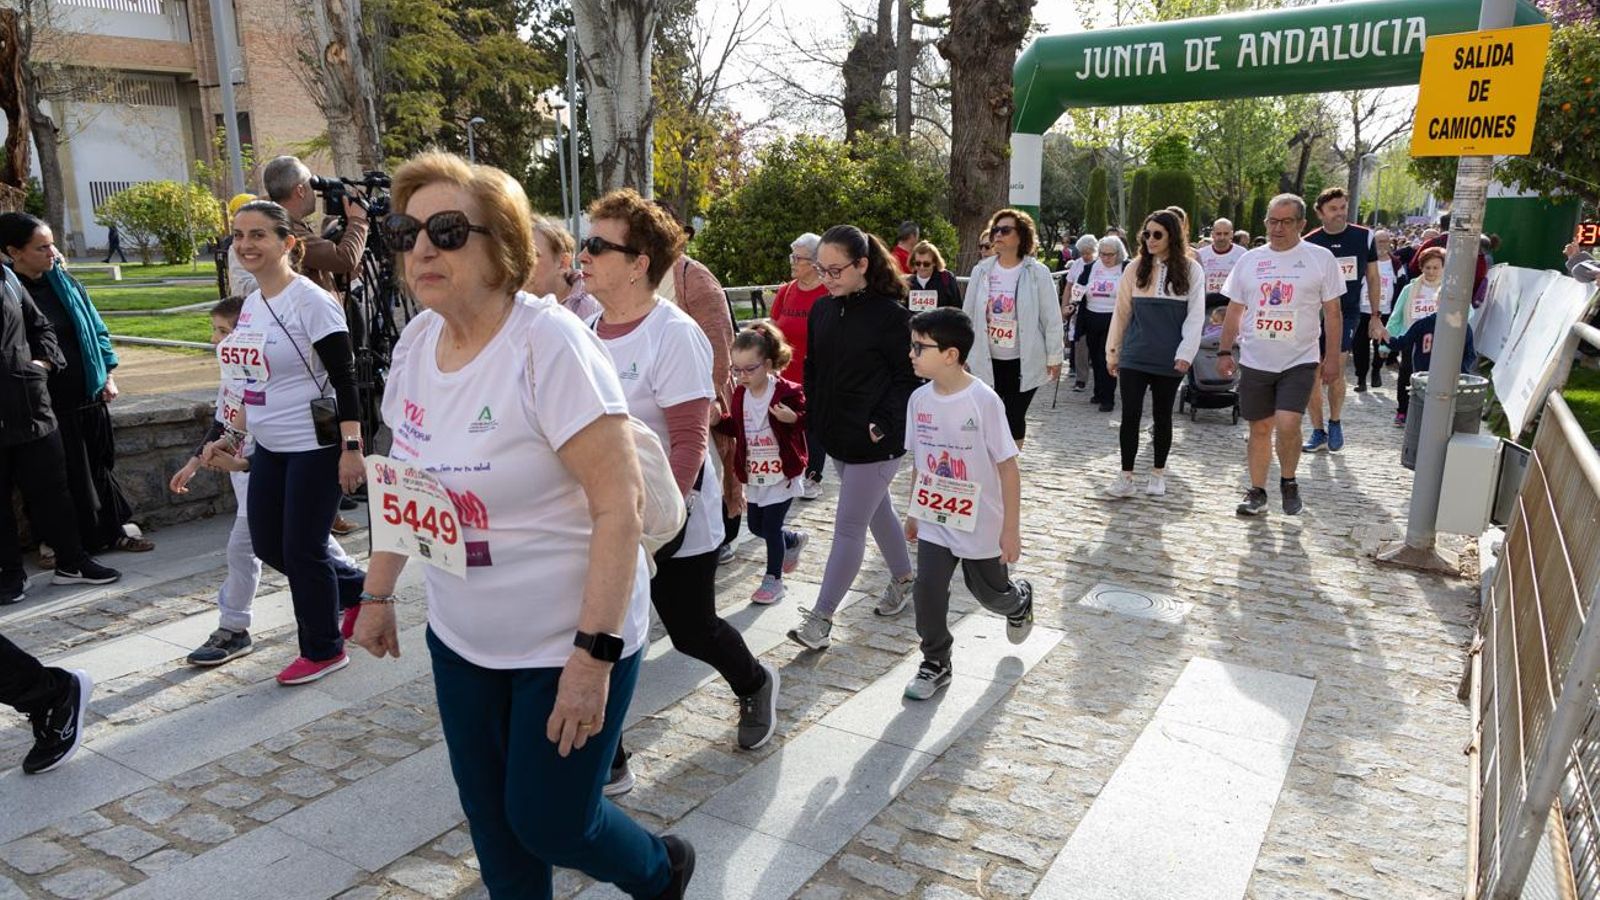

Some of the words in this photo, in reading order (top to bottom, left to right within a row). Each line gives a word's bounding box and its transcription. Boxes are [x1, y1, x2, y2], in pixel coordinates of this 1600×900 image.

[1075, 41, 1167, 80] JUNTA
[1184, 36, 1222, 72] DE
[1236, 16, 1426, 68] ANDALUCIA
[1453, 42, 1514, 70] SALIDA
[1468, 79, 1491, 102] DE
[1428, 115, 1517, 139] CAMIONES
[1256, 319, 1293, 332] 5703
[221, 347, 261, 366] 5572
[917, 488, 973, 516] 5242
[383, 492, 458, 545] 5449
